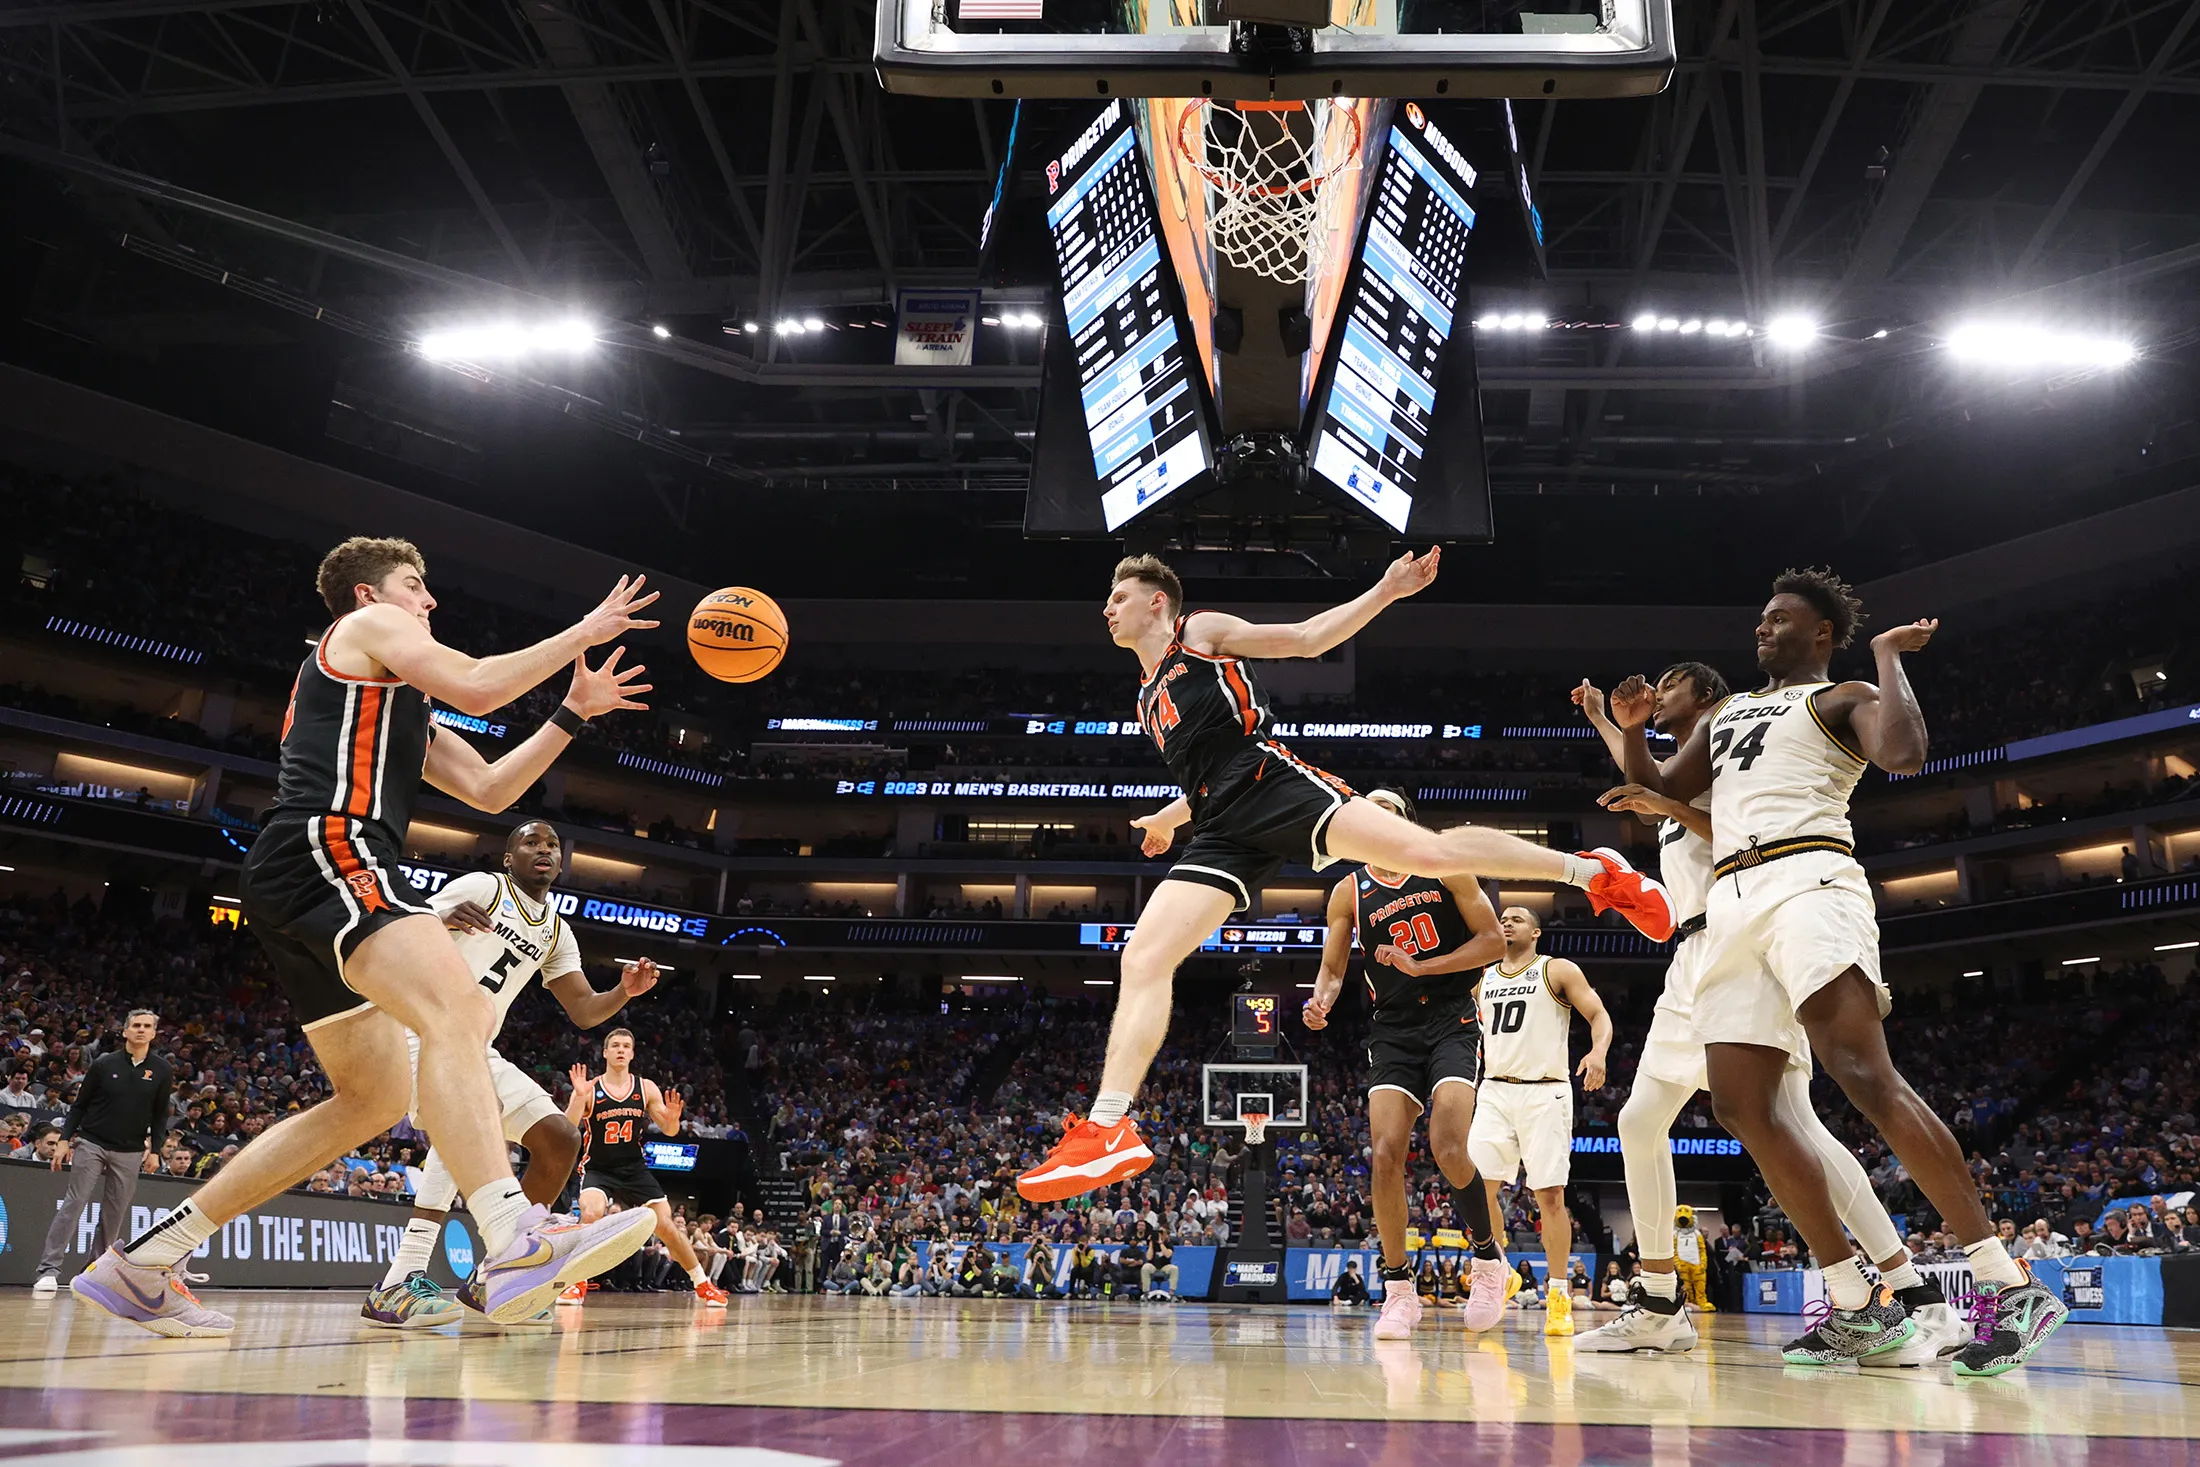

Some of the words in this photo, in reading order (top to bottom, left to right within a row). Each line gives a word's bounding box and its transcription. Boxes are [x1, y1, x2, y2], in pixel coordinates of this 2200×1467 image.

[1061, 98, 1120, 176] PRINCETON
[1398, 138, 1424, 170] PLAYER
[1424, 121, 1478, 188] MISSOURI
[1374, 227, 1388, 245] TEAM
[904, 321, 954, 333] SLEEP
[914, 332, 965, 343] TRAIN
[1353, 356, 1367, 373] TEAM
[1354, 382, 1372, 402] BONUS
[1097, 398, 1111, 416] TEAM
[1107, 411, 1125, 432] BONUS
[693, 618, 755, 642] Wilson
[1150, 686, 1182, 754] 14
[1713, 705, 1792, 730] MIZZOU
[1074, 721, 1119, 735] 2023
[1121, 721, 1142, 735] DI
[1303, 723, 1433, 738] CHAMPIONSHIP
[1711, 721, 1773, 782] 24
[884, 782, 927, 795] 2023
[931, 783, 951, 795] DI
[954, 783, 1003, 796] MEN'S
[1007, 784, 1107, 797] BASKETBALL
[582, 900, 683, 934] ROUNDS
[1368, 890, 1443, 927] PRINCETON
[492, 921, 544, 963] MIZZOU
[1246, 931, 1288, 942] MIZZOU
[1297, 930, 1315, 943] 45
[1388, 912, 1441, 957] 20
[479, 948, 522, 994] 5
[1484, 985, 1537, 1000] MIZZOU
[1246, 998, 1274, 1011] 4:59
[1255, 1012, 1270, 1033] 5
[1491, 1000, 1526, 1035] 10
[604, 1120, 633, 1144] 24
[652, 1144, 684, 1155] MARCH
[655, 1155, 696, 1167] MADNESS
[221, 1214, 251, 1259] TO
[258, 1215, 305, 1261] THE
[311, 1220, 372, 1264] FINAL
[1437, 1231, 1461, 1239] DEFENSE
[449, 1247, 474, 1264] NCAA
[1236, 1264, 1264, 1273] MARCH
[1239, 1273, 1276, 1283] MADNESS
